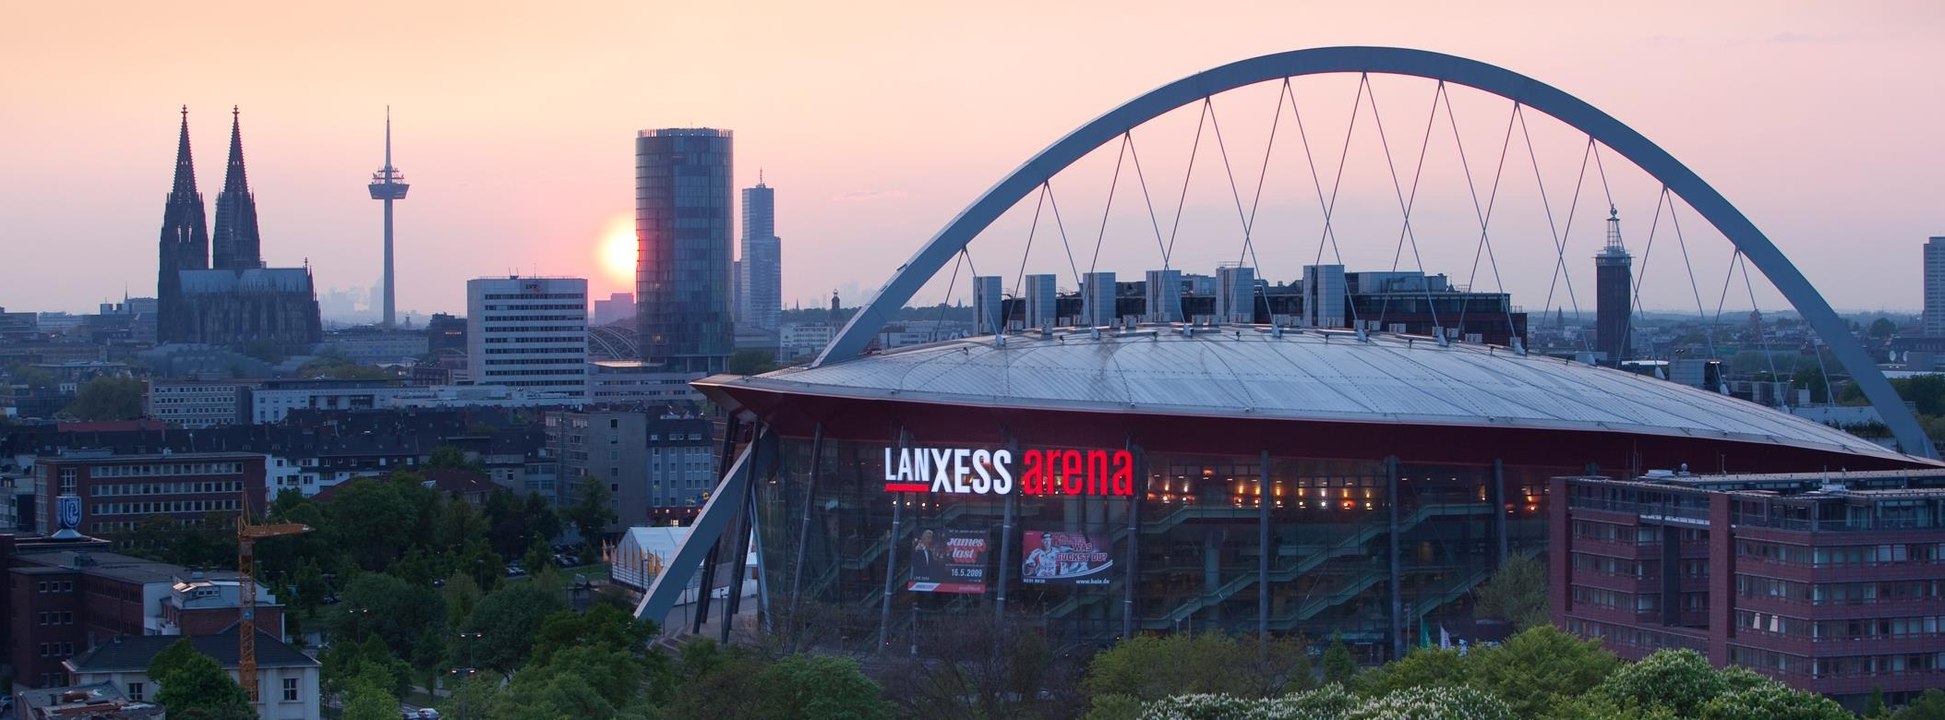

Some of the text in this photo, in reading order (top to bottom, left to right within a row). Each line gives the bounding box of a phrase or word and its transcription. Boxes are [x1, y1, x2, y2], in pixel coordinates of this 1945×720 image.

[885, 448, 1134, 496] LANXESS arena
[1072, 543, 1093, 552] WAS
[1091, 553, 1108, 562] DU?
[951, 568, 983, 577] 16.5.2009
